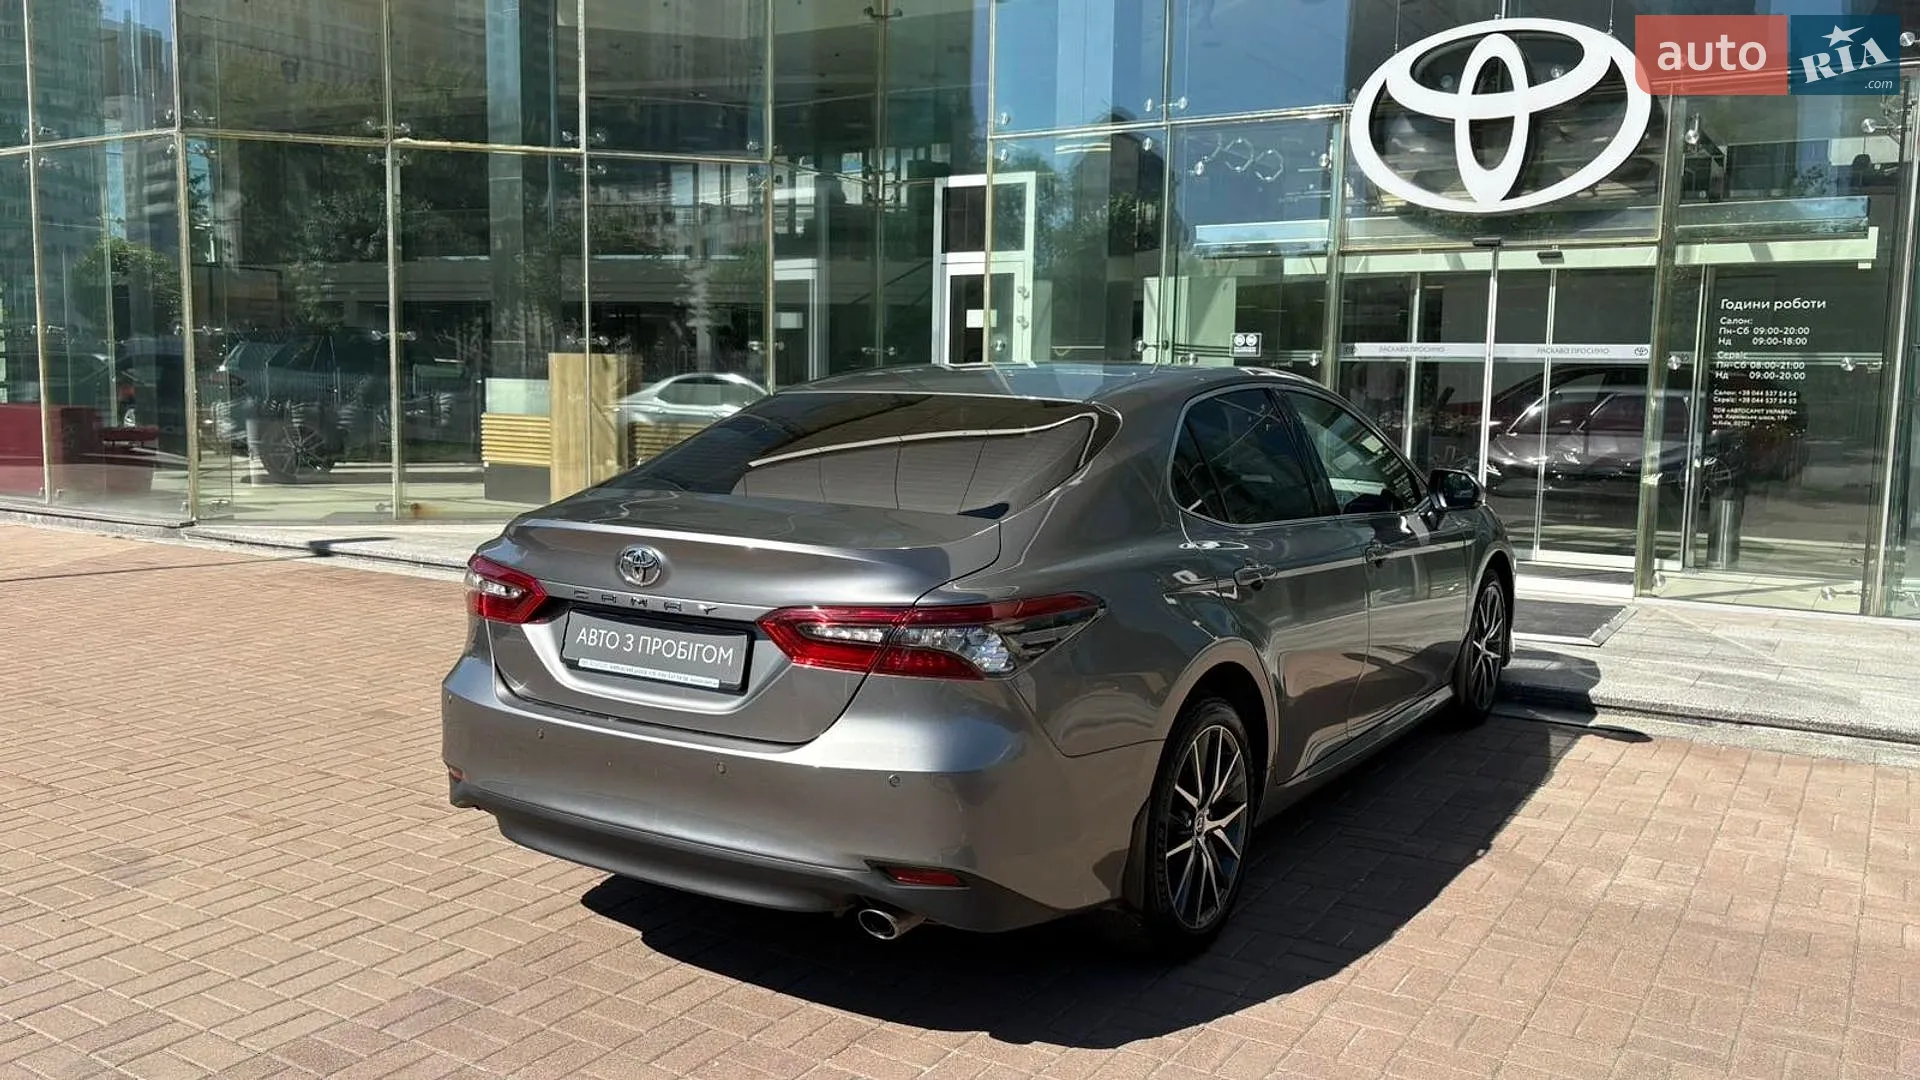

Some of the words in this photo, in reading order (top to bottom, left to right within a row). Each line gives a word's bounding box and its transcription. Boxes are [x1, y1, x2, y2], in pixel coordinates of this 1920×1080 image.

[1720, 298, 1770, 311] Години
[1773, 297, 1827, 312] роботи
[1719, 316, 1753, 325] Салон:
[1718, 326, 1750, 335] Пн-Сб
[1718, 337, 1732, 346] Нд
[1715, 361, 1747, 369] Пн-Сб
[1714, 371, 1729, 380] Нд
[575, 627, 620, 650] АВТО
[638, 635, 734, 667] ПРОБІГОМ
